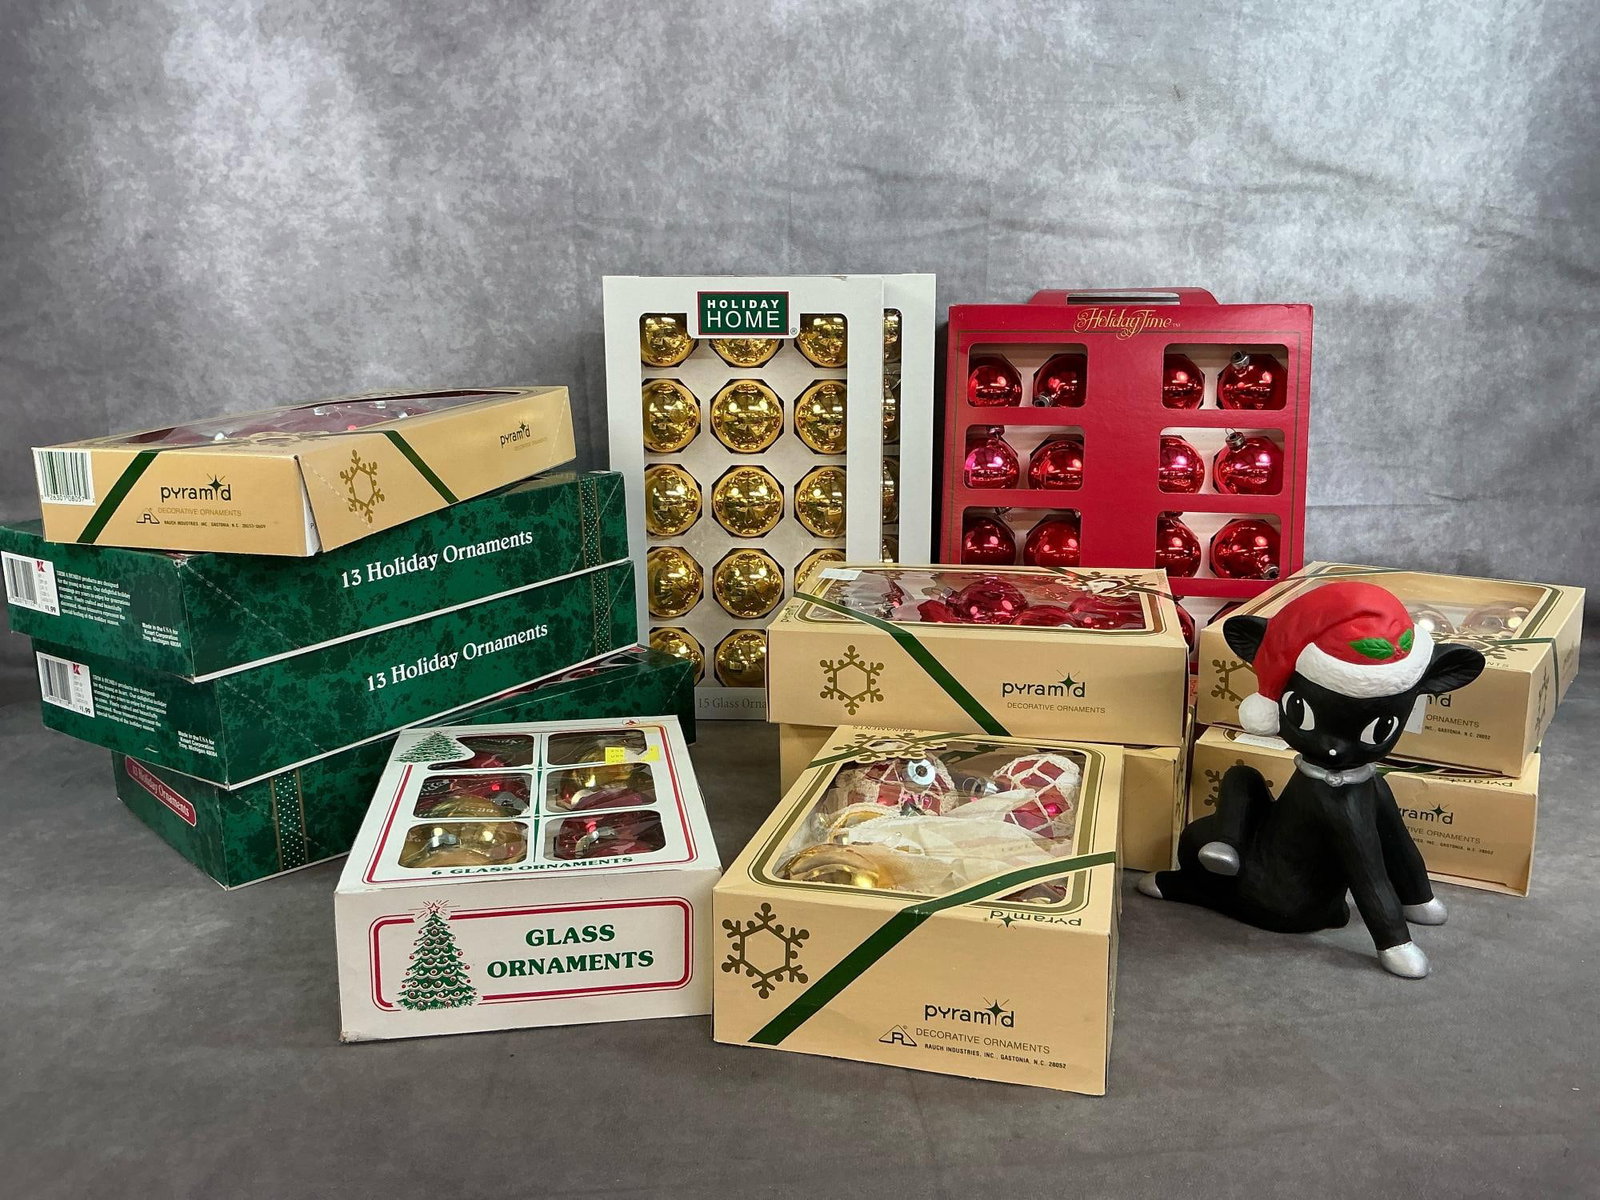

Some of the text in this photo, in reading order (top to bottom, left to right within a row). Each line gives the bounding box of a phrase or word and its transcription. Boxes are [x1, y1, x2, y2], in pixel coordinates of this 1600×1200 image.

[707, 299, 779, 309] HOLIDAY
[707, 310, 780, 328] HOME
[500, 420, 531, 449] pyramid
[160, 475, 232, 503] pyramid
[158, 507, 242, 517] DECORATIVE ORNAMENTS
[341, 531, 533, 588] 13 Holiday Ornaments
[367, 624, 548, 691] 13 Holiday Ornaments
[1002, 673, 1086, 697] pyramid
[699, 697, 710, 709] 15
[712, 697, 739, 708] Glass
[1007, 702, 1106, 714] DECORATIVE ORNAMENTS
[1426, 714, 1479, 728] ORNAMENTS
[138, 767, 158, 794] Holiday
[159, 785, 189, 817] Ornaments
[1398, 804, 1454, 825] ramid
[1426, 830, 1481, 844] ORNAMENTS
[450, 866, 513, 875] GLASS
[518, 856, 633, 870] ORNAMENTS
[990, 910, 1082, 927] pyramid
[525, 924, 615, 946] GLASS
[487, 950, 654, 978] ORNAMENTS
[924, 1000, 1015, 1028] pyramid
[916, 1027, 1050, 1054] DECORATIVE ORNAMENTS
[924, 1043, 944, 1051] RAUCH
[946, 1046, 982, 1057] INDUSTRIES,
